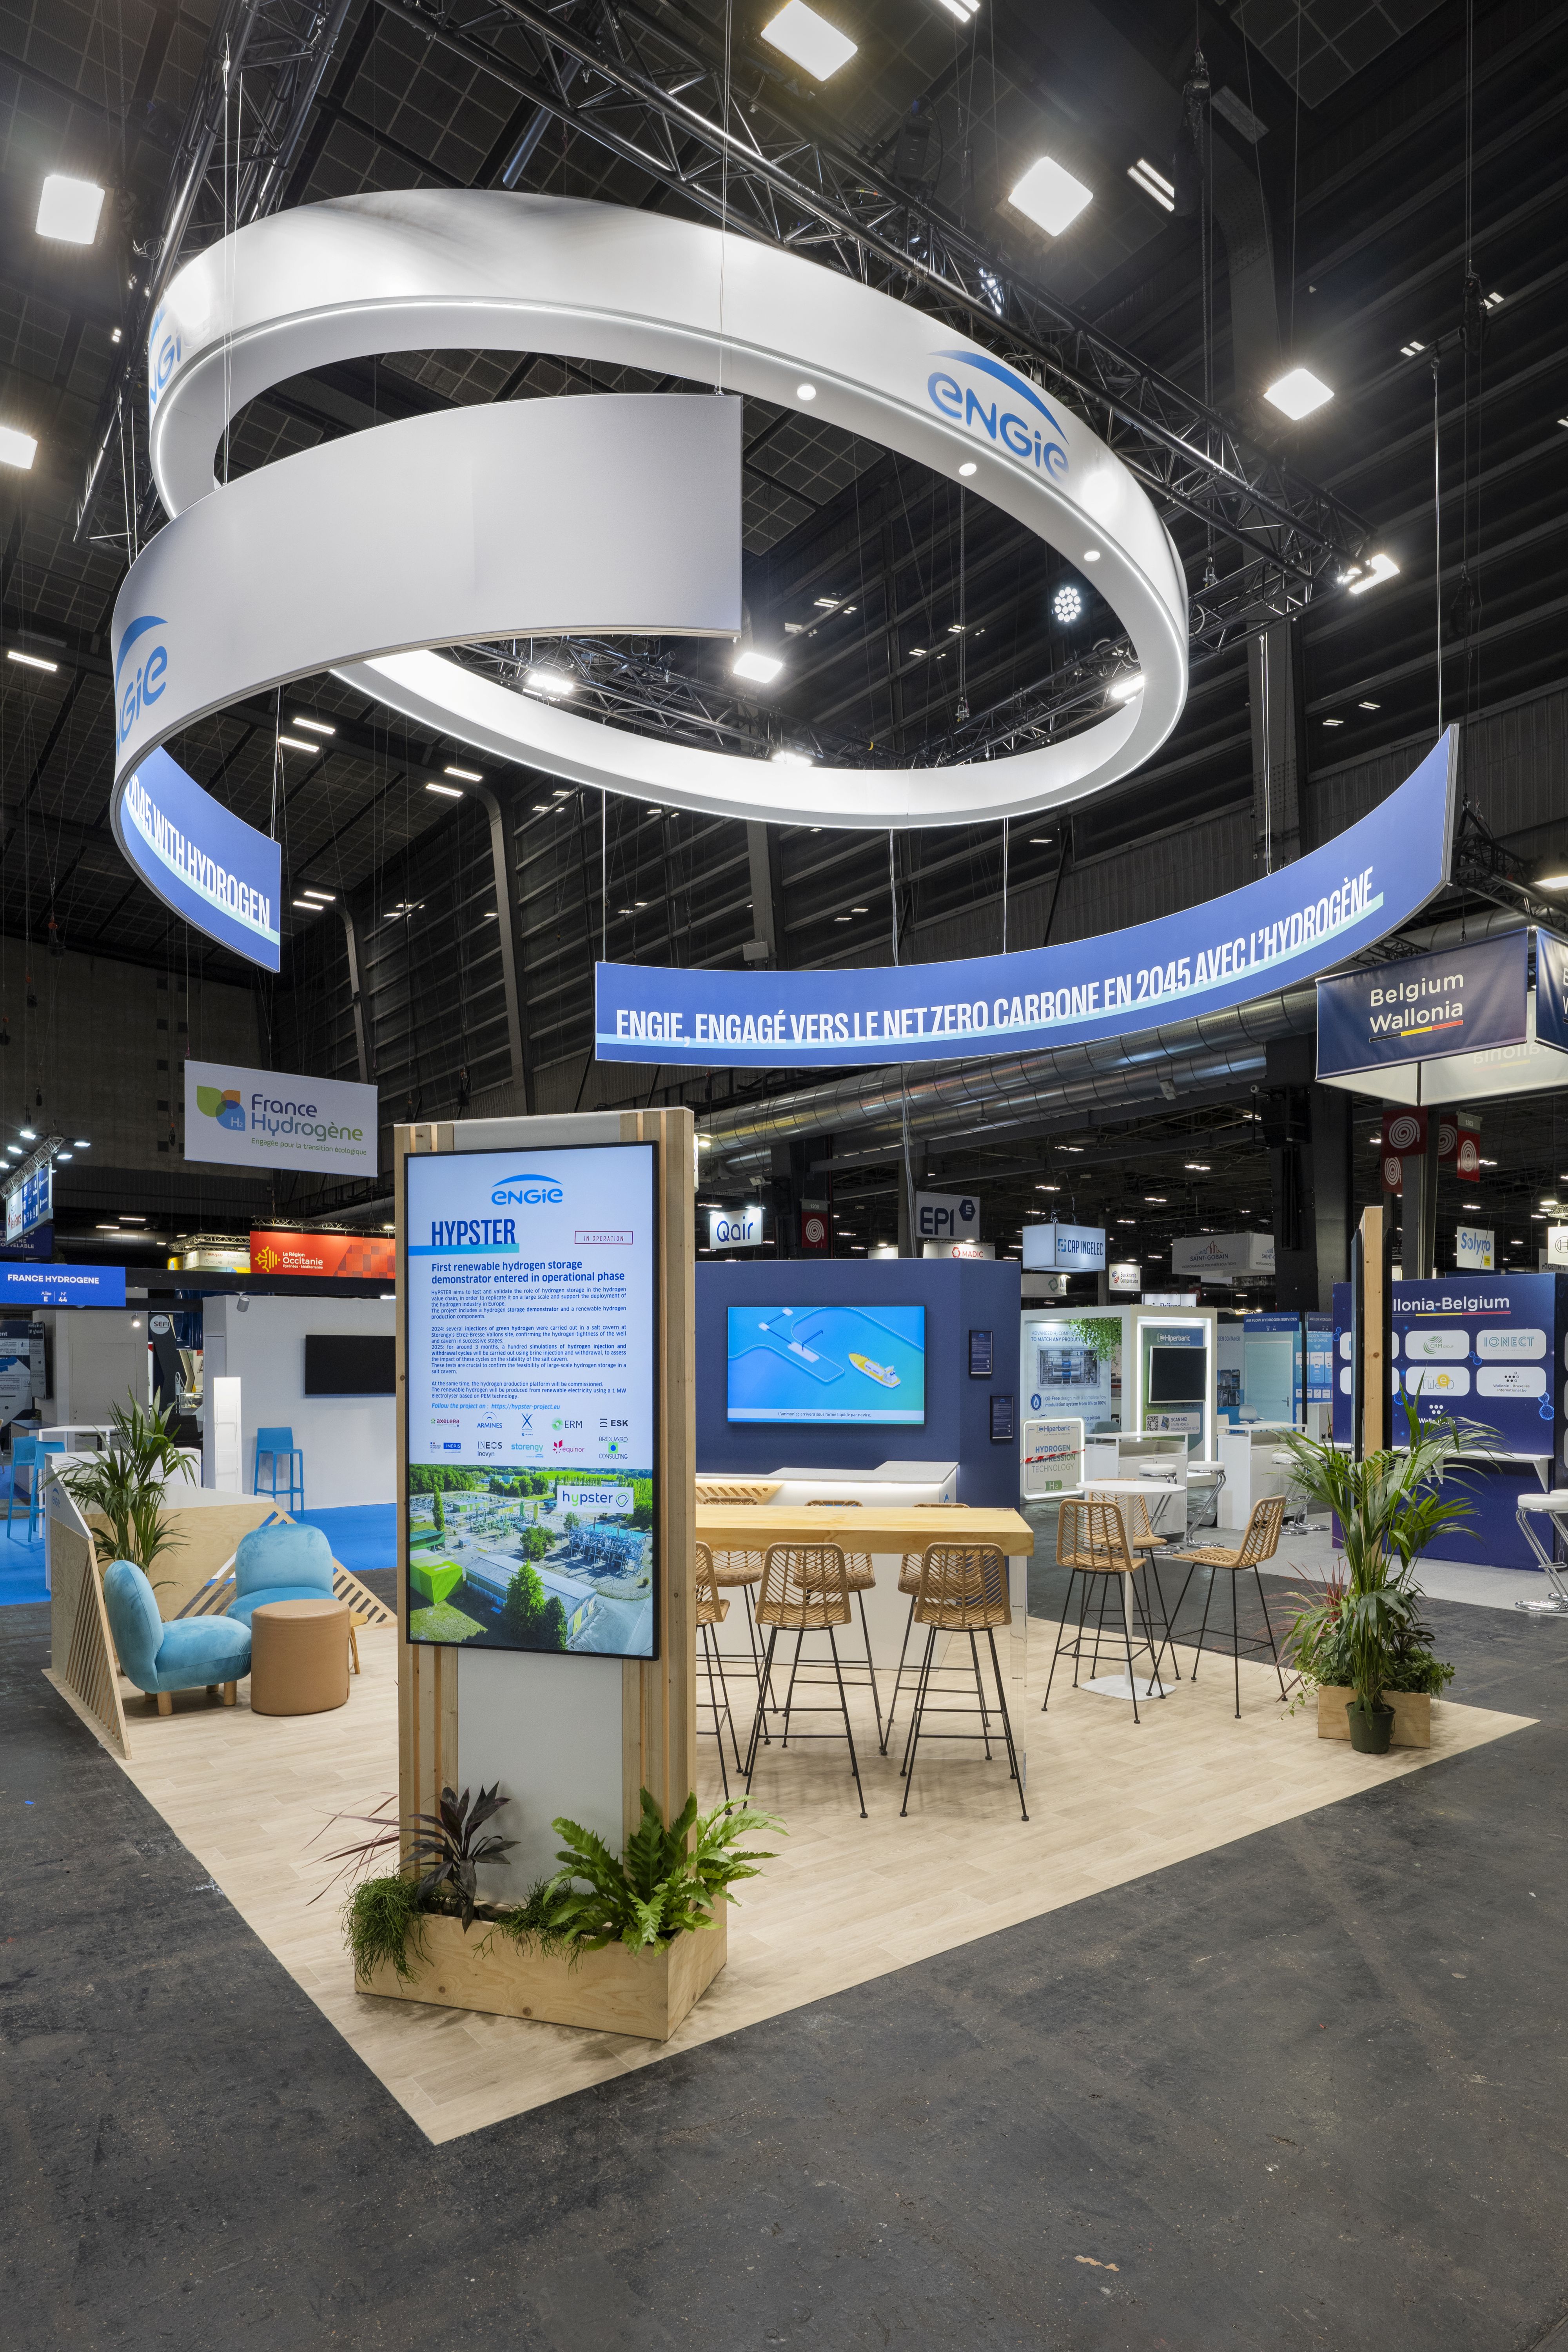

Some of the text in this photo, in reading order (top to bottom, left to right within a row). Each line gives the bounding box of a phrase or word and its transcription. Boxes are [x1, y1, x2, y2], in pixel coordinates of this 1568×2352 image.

[153, 803, 185, 875] WITH
[187, 840, 270, 933] HYDROGEN
[617, 1009, 690, 1047] ENGIE,
[695, 1009, 786, 1044] ENGAGÉ
[790, 1013, 849, 1043] VERS
[854, 1011, 878, 1041] LE
[884, 1007, 927, 1040] NET
[931, 1001, 988, 1036] ZERO
[993, 982, 1099, 1029] CARBONE
[1104, 974, 1132, 1011] EN
[1136, 956, 1191, 1004] 2045
[1194, 937, 1246, 989] AVEC
[1370, 974, 1464, 1007] Belgium
[1369, 1000, 1463, 1034] Wallonia
[252, 1093, 318, 1118] France
[252, 1112, 363, 1142] Hydrogène
[251, 1138, 278, 1147] Engagée
[303, 1143, 333, 1152] transition
[334, 1146, 367, 1156] écologique
[717, 1216, 753, 1242] Qair
[920, 1206, 954, 1236] EPI
[432, 1219, 516, 1247] HYPSTER
[1067, 1240, 1103, 1256] CAP INGELEC
[1461, 1232, 1491, 1255] Solyro
[283, 1256, 323, 1266] Occitanie
[432, 1260, 582, 1272] First renewable hydrogen storage
[7, 1274, 100, 1284] FRANCE HYDROGENE
[432, 1271, 625, 1284] demonstrator entered in operational phase
[1393, 1296, 1510, 1312] llonia-Belgium
[1165, 1334, 1191, 1343] Hiperbaric
[1484, 1336, 1535, 1347] IONECT
[564, 1420, 583, 1428] ERM
[1044, 1425, 1071, 1433] Hiperbaric
[477, 1441, 502, 1449] INEOS
[511, 1443, 543, 1452] storengy
[1035, 1444, 1071, 1453] HYDROGEN
[1032, 1463, 1074, 1473] TECHNOLOGY
[563, 1490, 613, 1506] hypster
